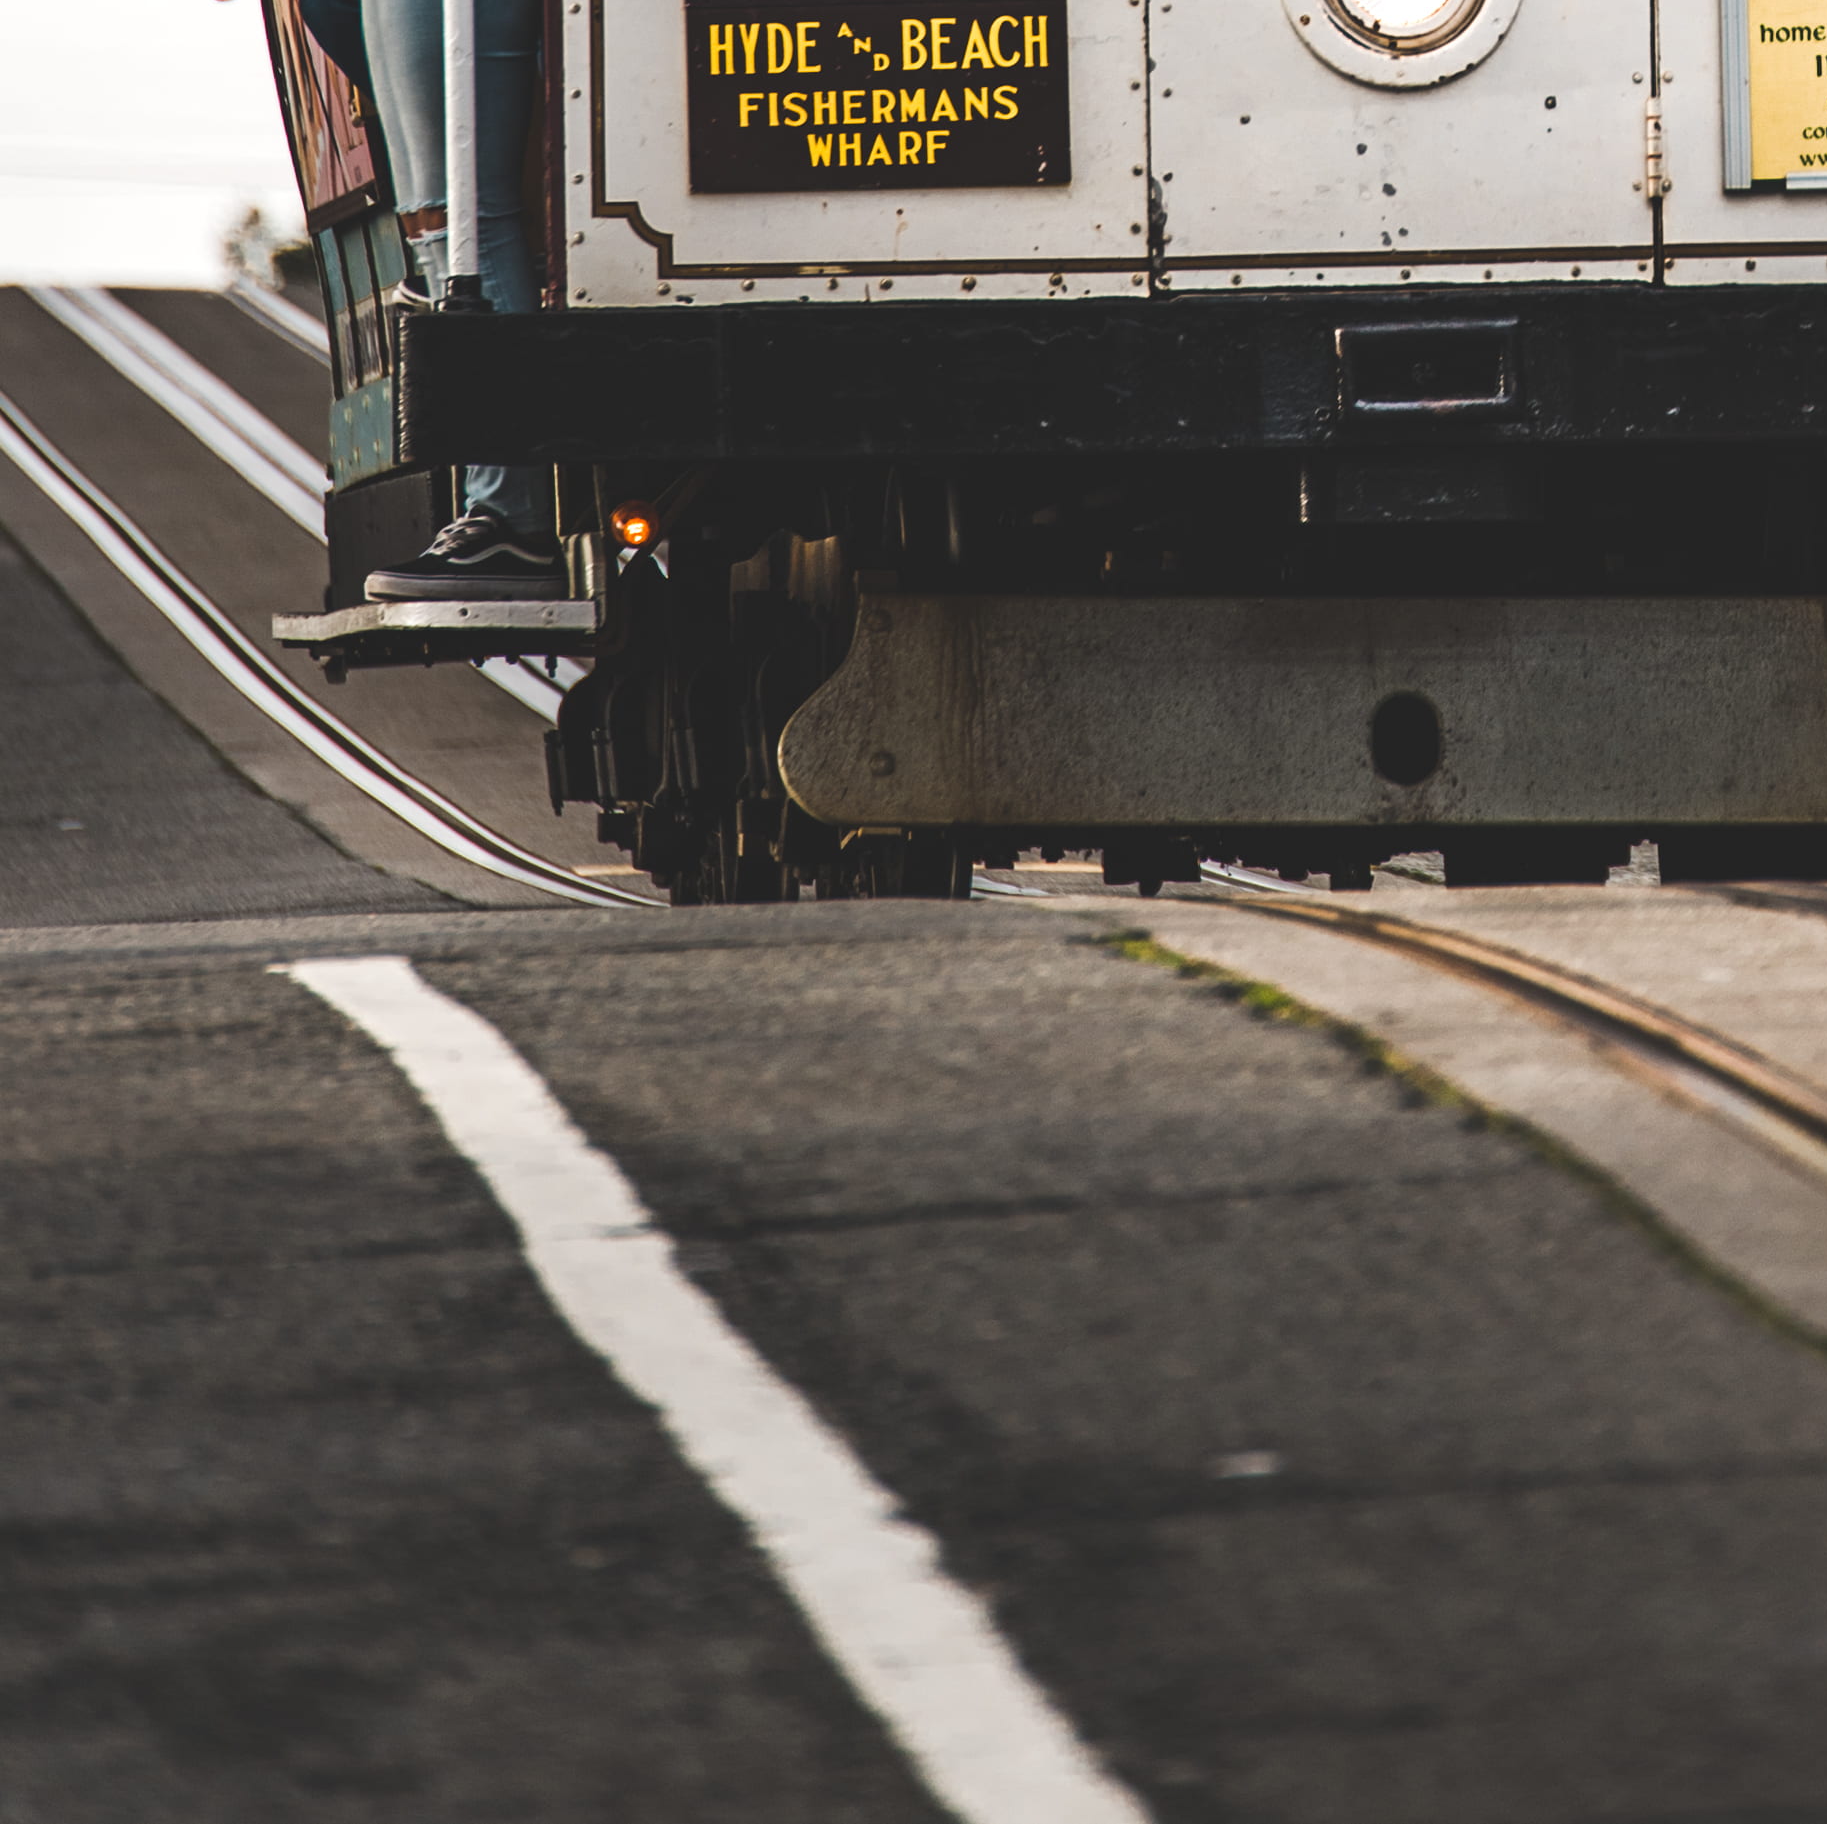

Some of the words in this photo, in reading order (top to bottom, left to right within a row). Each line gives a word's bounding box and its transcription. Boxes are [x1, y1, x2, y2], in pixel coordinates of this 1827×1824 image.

[709, 22, 821, 75] HYDE
[837, 23, 890, 71] AND
[902, 15, 1048, 71] BEACH
[1760, 22, 1826, 43] home
[739, 86, 1018, 127] FISHERMANS
[807, 131, 949, 167] WHARF
